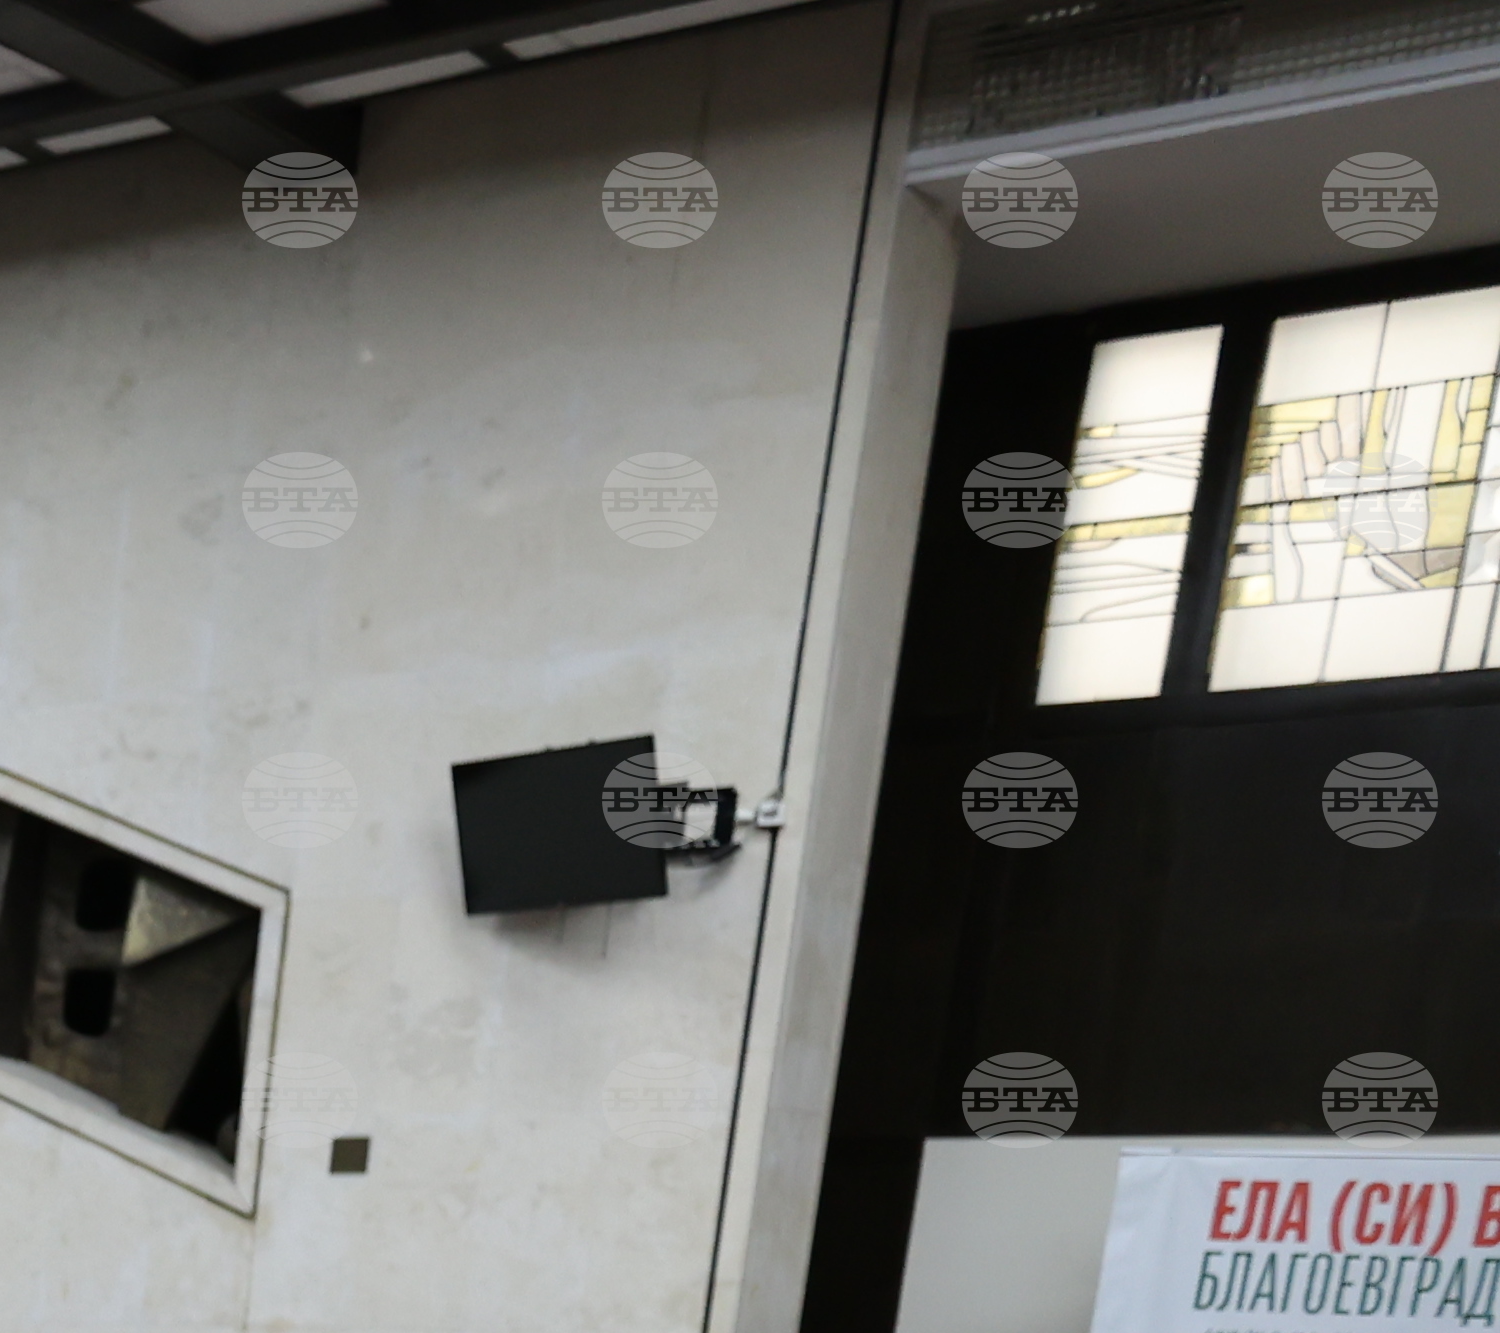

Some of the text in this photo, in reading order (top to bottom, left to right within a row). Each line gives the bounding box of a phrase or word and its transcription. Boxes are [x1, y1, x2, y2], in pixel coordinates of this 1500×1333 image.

[1207, 1180, 1312, 1243] ЕЛА
[1329, 1180, 1457, 1256] (СИ)
[1193, 1250, 1500, 1328] БЛАГОЕВГРАД
